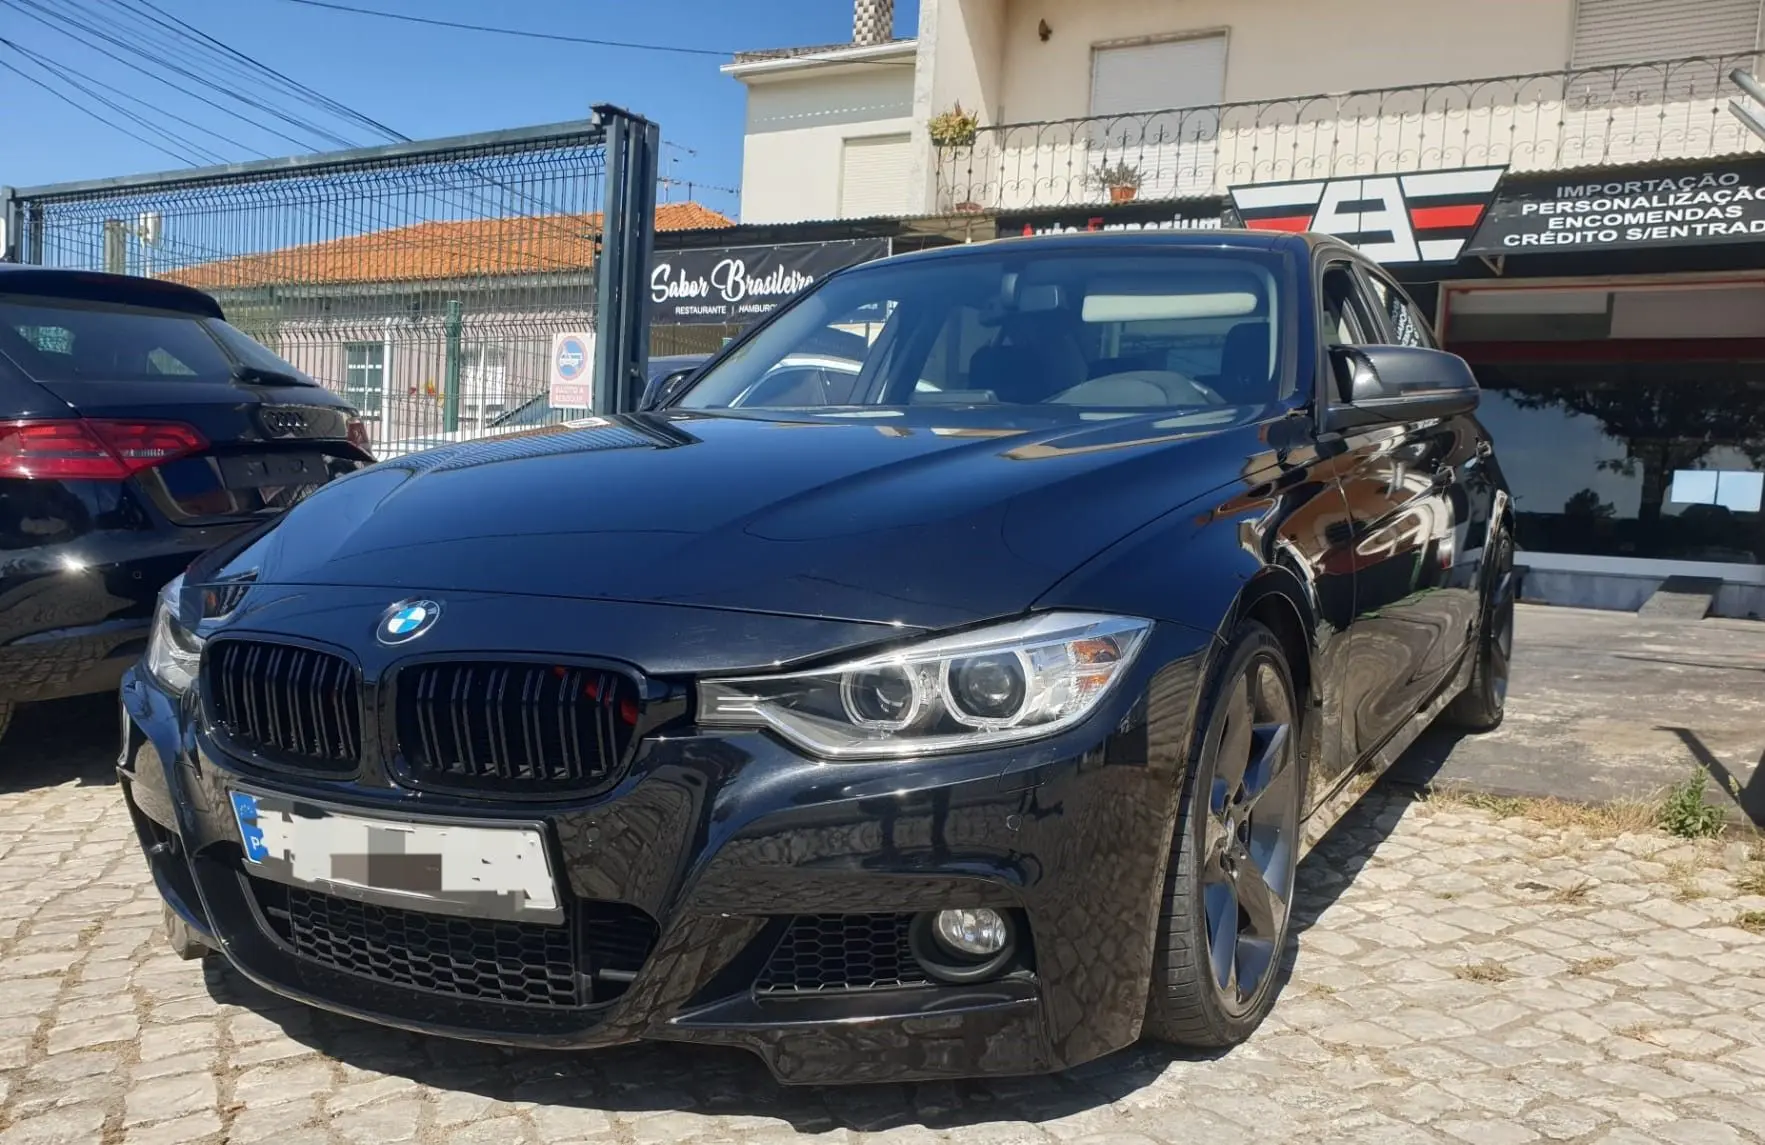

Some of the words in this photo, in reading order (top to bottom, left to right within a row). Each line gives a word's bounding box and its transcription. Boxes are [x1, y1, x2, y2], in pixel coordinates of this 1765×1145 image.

[1556, 172, 1740, 198] IMPORTAÇÃO
[1521, 185, 1765, 215] PERSONALIZAÇÃO
[1547, 205, 1743, 229] ENCOMENDAS
[1503, 230, 1618, 246] CRÉDITO
[651, 264, 709, 303] Sabor
[675, 305, 726, 315] RESTAURANTE
